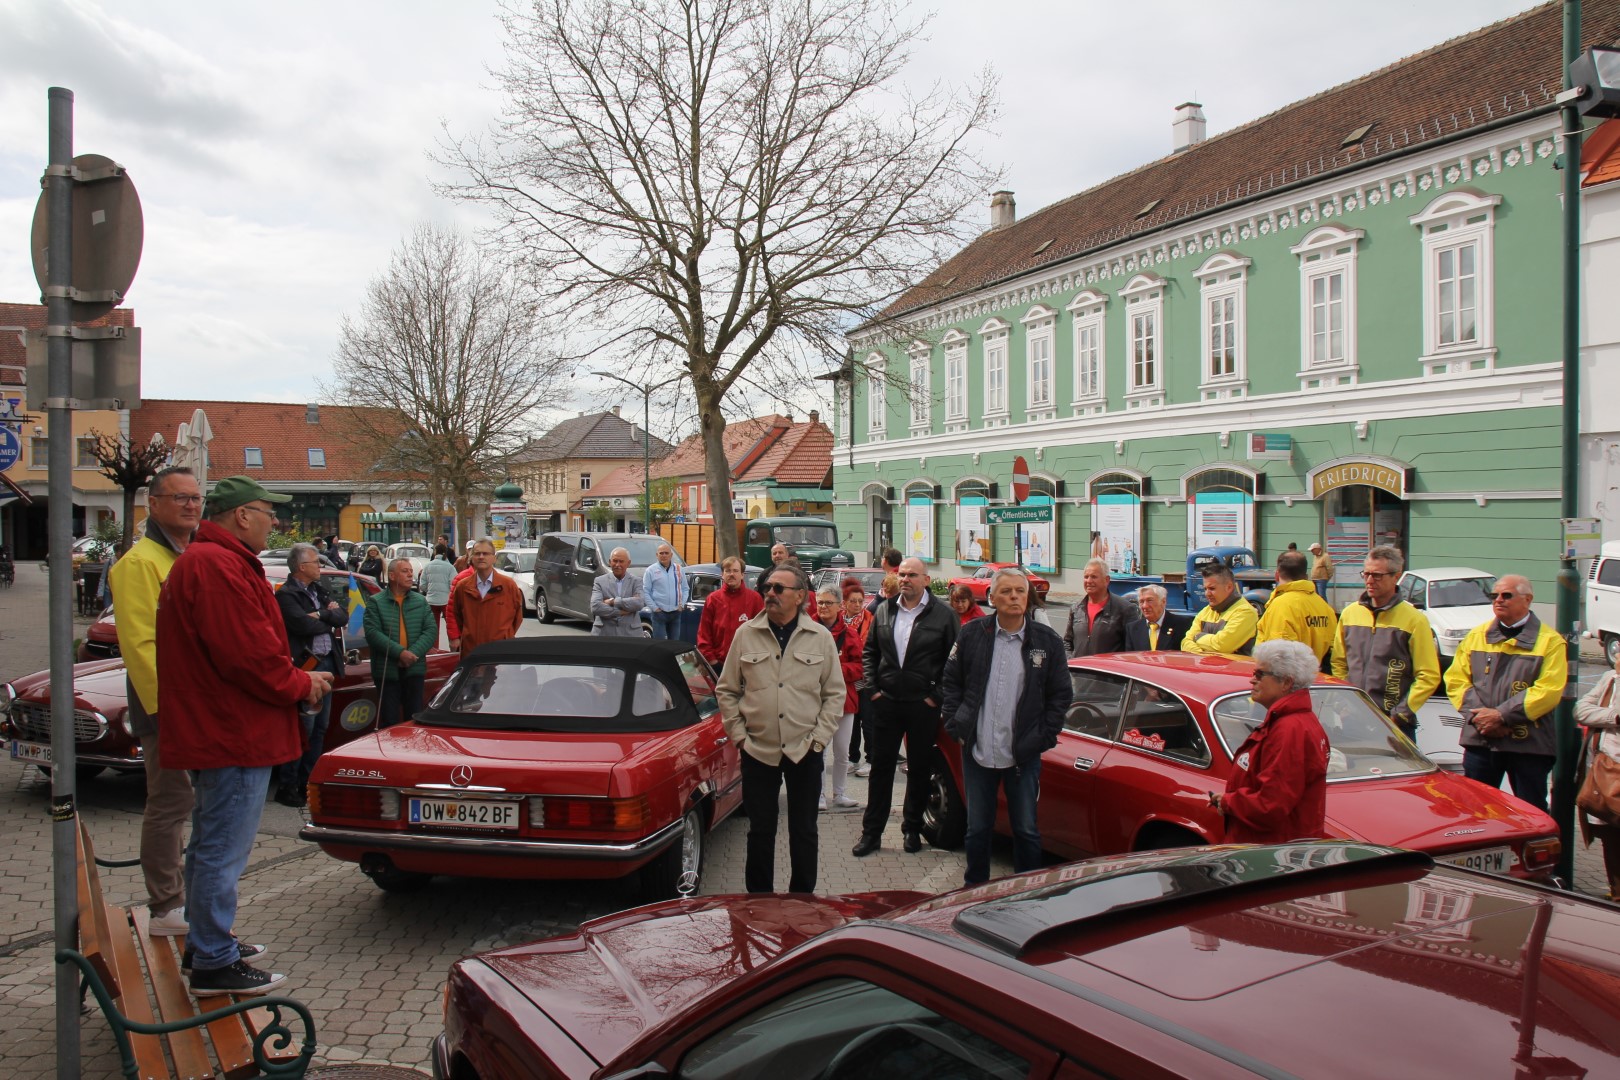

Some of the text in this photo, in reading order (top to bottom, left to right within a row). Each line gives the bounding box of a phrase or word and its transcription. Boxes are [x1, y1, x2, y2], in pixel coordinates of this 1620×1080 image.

[0, 448, 17, 456] MER
[1318, 467, 1397, 489] FRIEDRICH
[1001, 509, 1049, 520] Öffentliches WC
[347, 705, 369, 725] 48
[337, 768, 384, 778] 280 SL
[422, 803, 513, 824] OW 842 BF
[1484, 852, 1504, 872] PW
